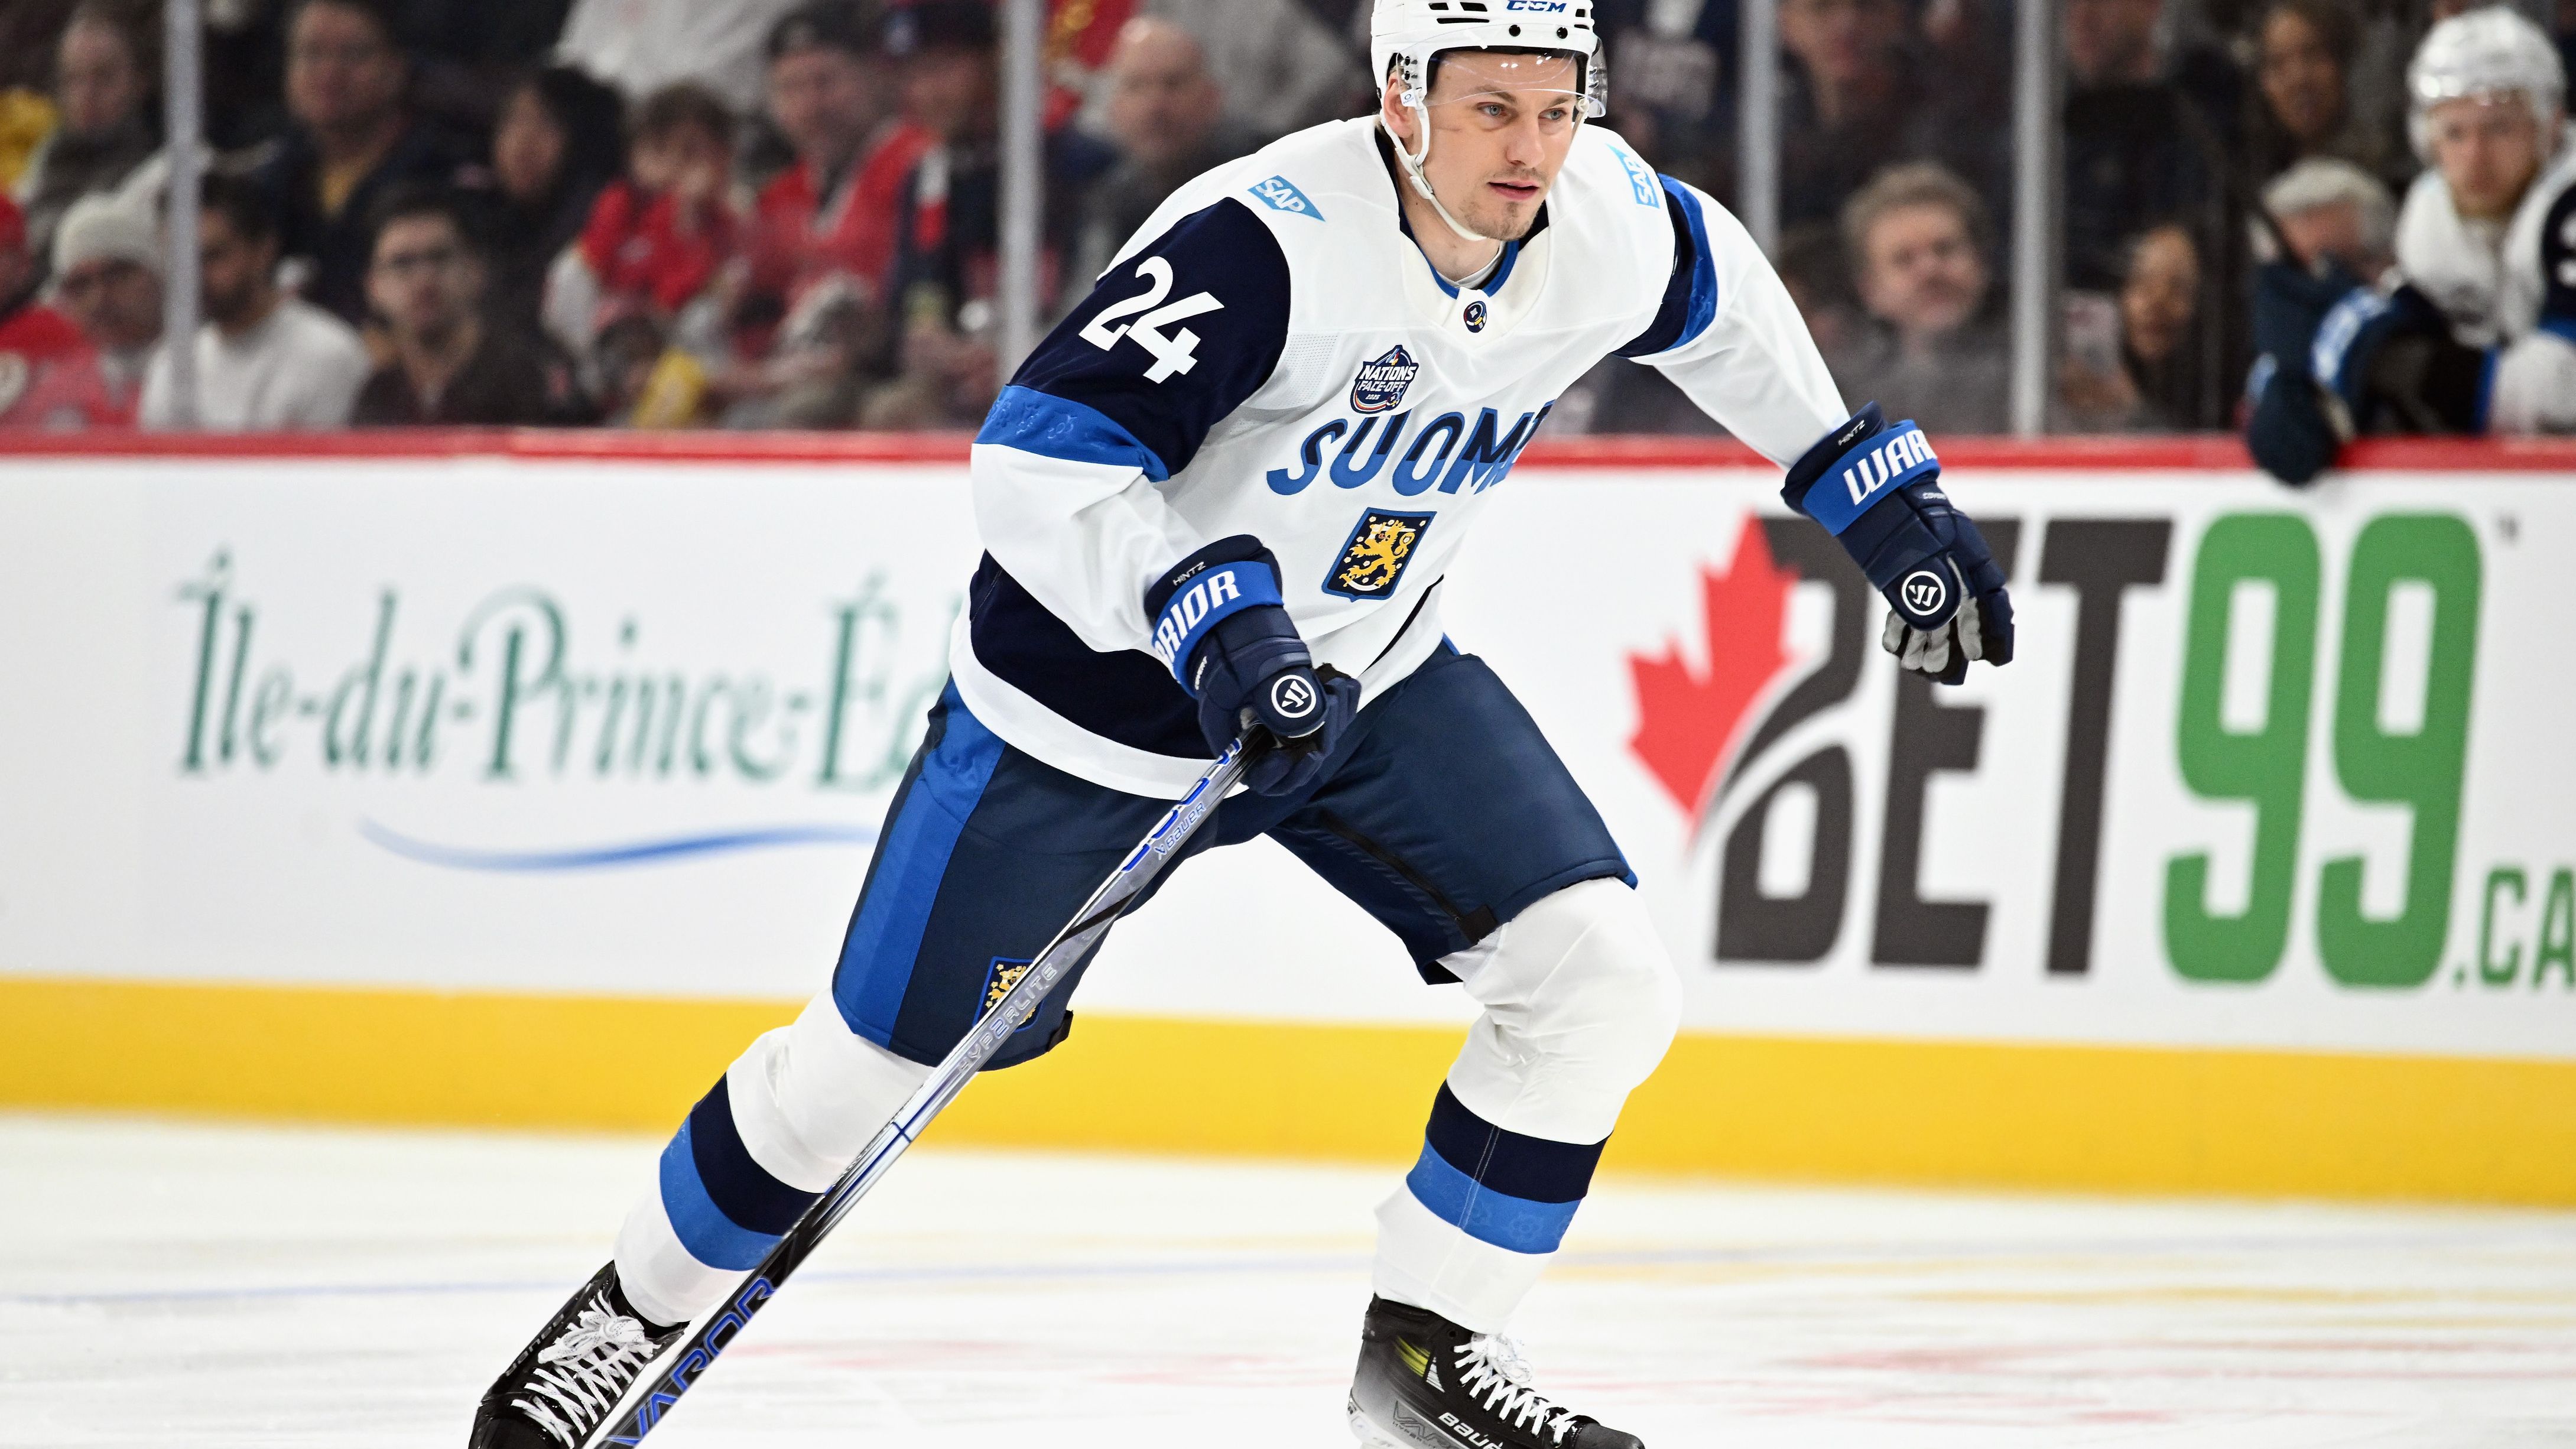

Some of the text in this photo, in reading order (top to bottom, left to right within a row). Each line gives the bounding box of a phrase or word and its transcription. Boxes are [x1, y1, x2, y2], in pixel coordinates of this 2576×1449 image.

[1506, 0, 1567, 12] CCM
[1623, 156, 1655, 205] SAP
[1255, 179, 1305, 212] SAP
[1079, 256, 1224, 384] 24
[1359, 365, 1417, 381] NATIONS
[1172, 561, 1206, 586] HINTZ
